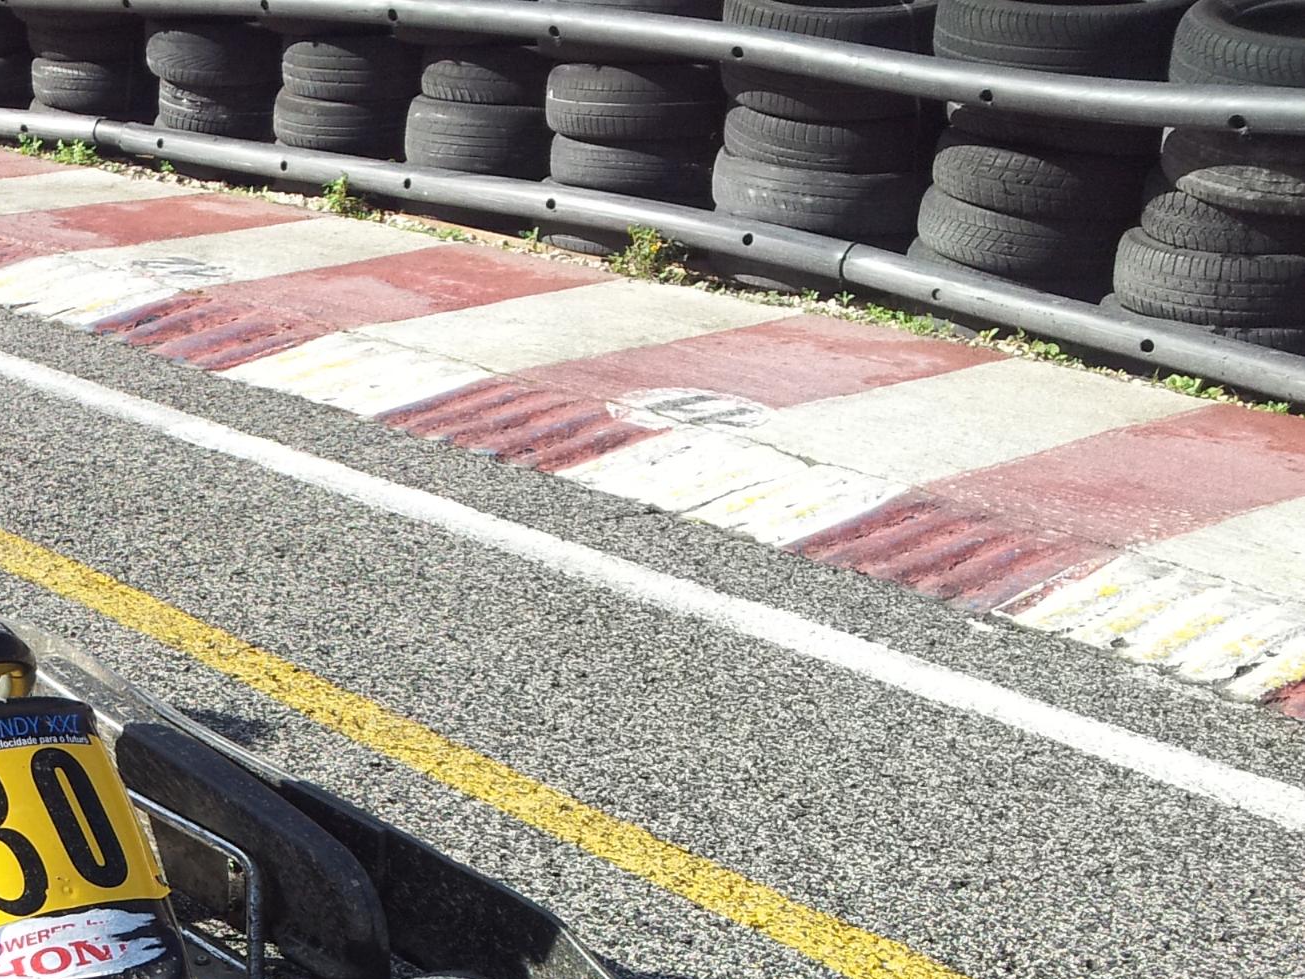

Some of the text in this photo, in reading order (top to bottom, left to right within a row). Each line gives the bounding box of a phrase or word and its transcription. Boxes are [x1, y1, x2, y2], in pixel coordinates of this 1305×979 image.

[45, 714, 80, 734] XXI
[39, 735, 58, 745] para
[59, 736, 65, 744] o
